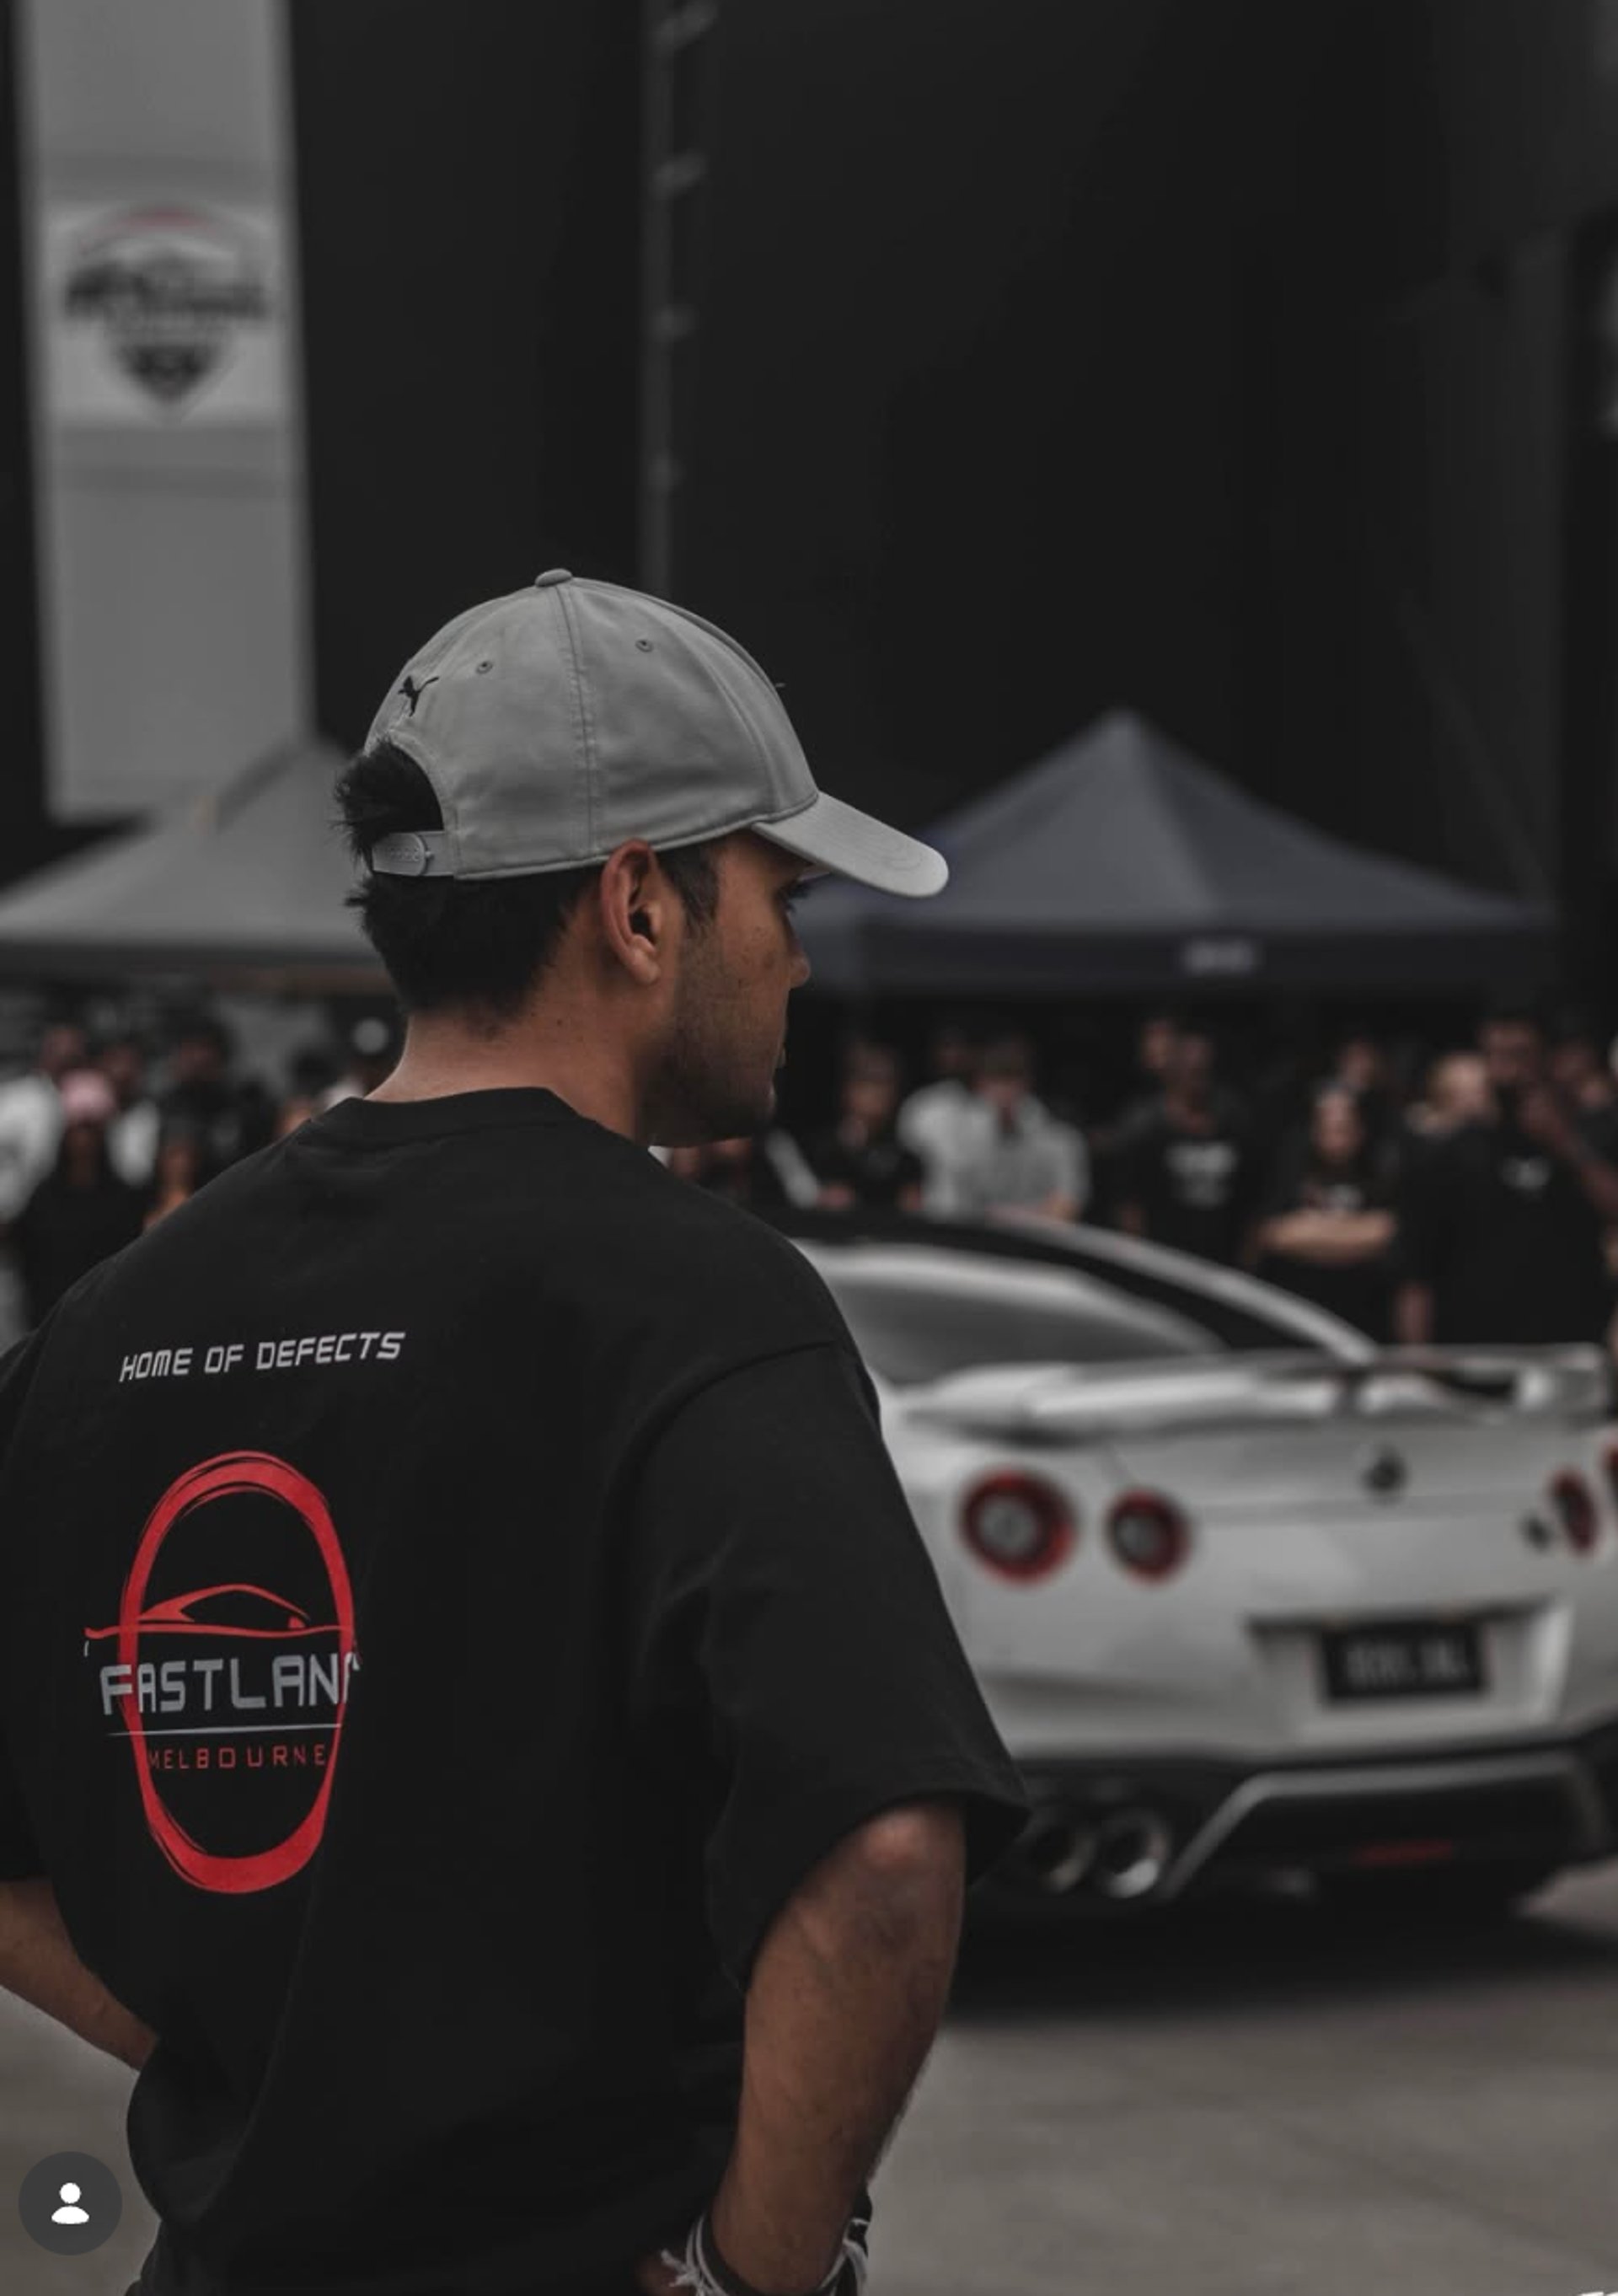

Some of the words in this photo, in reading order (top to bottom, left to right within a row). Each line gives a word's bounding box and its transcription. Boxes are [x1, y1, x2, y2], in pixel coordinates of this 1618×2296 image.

[118, 1348, 193, 1382] HOME
[204, 1344, 244, 1374] OF
[255, 1332, 406, 1370] DEFECTS
[148, 1744, 326, 1770] MELBOURNE
